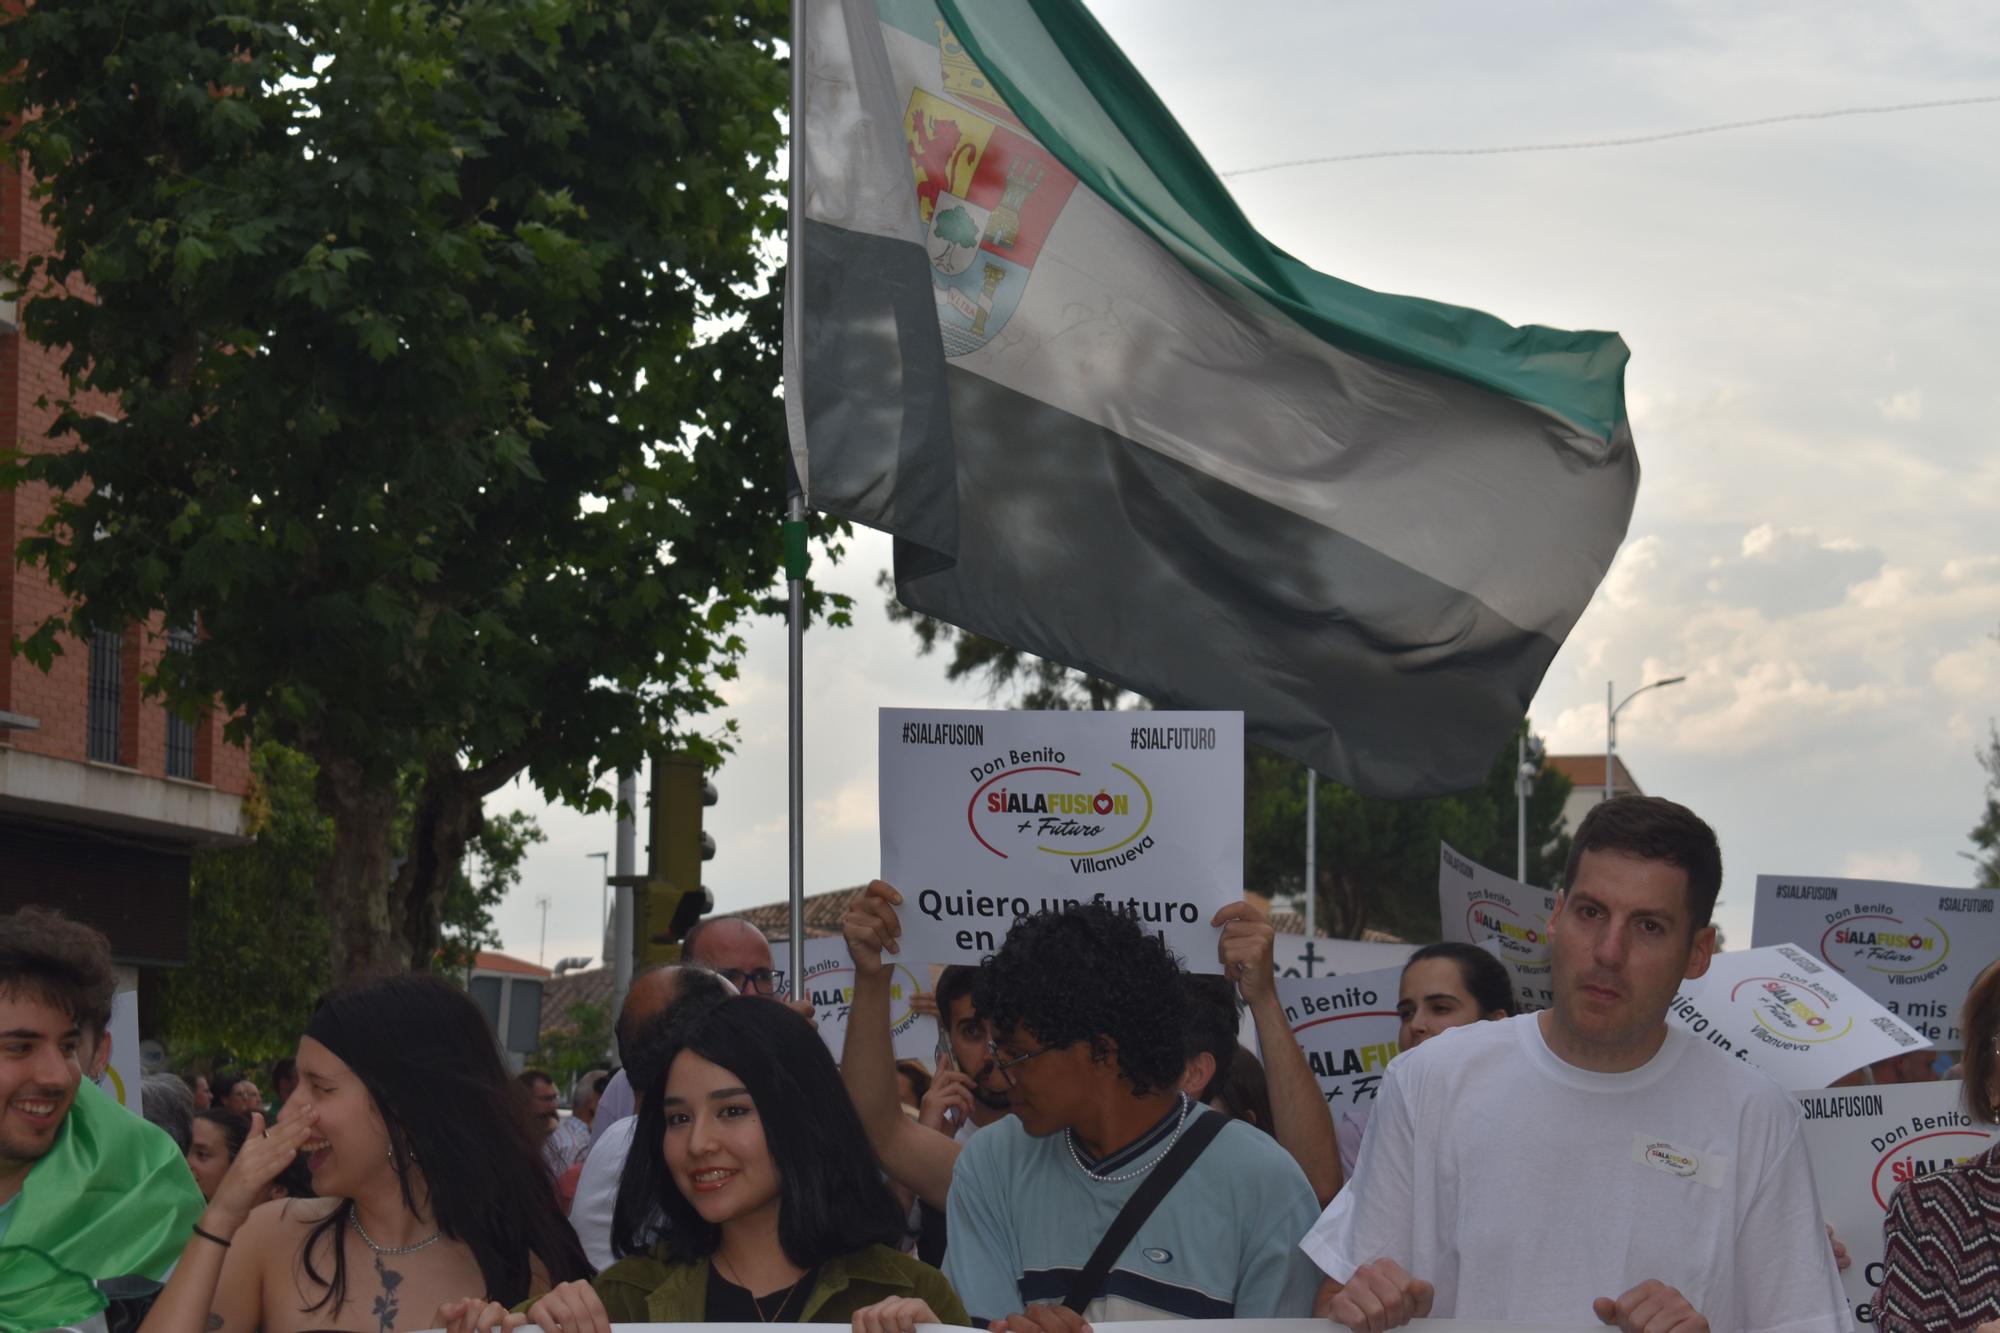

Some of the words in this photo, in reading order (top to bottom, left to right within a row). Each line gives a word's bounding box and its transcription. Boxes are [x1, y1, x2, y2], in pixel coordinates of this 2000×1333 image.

[902, 722, 984, 746] #SIALAFUSION
[1130, 727, 1216, 750] #SIALFUTURO
[970, 757, 1005, 783] Don
[1009, 747, 1066, 766] Benito
[1037, 817, 1105, 837] Futuro
[1070, 835, 1155, 874] Villanueva
[1776, 885, 1838, 901] #SIALAFUSION
[919, 889, 1030, 921] Quiero
[1825, 910, 1851, 925] Don
[1854, 903, 1894, 915] Benito
[1938, 897, 1994, 913] #SIALFUTURO
[956, 930, 994, 951] en
[1867, 948, 1914, 962] Futuro
[1779, 972, 1808, 985] Don
[1888, 963, 1948, 985] Villanueva
[1301, 987, 1378, 1015] Benito
[1907, 1000, 1948, 1018] mis
[1750, 1024, 1811, 1052] Villanueva
[1800, 1095, 1883, 1120] SIALAFUSION
[1871, 1125, 1908, 1153] Don
[1911, 1111, 1972, 1133] Benito
